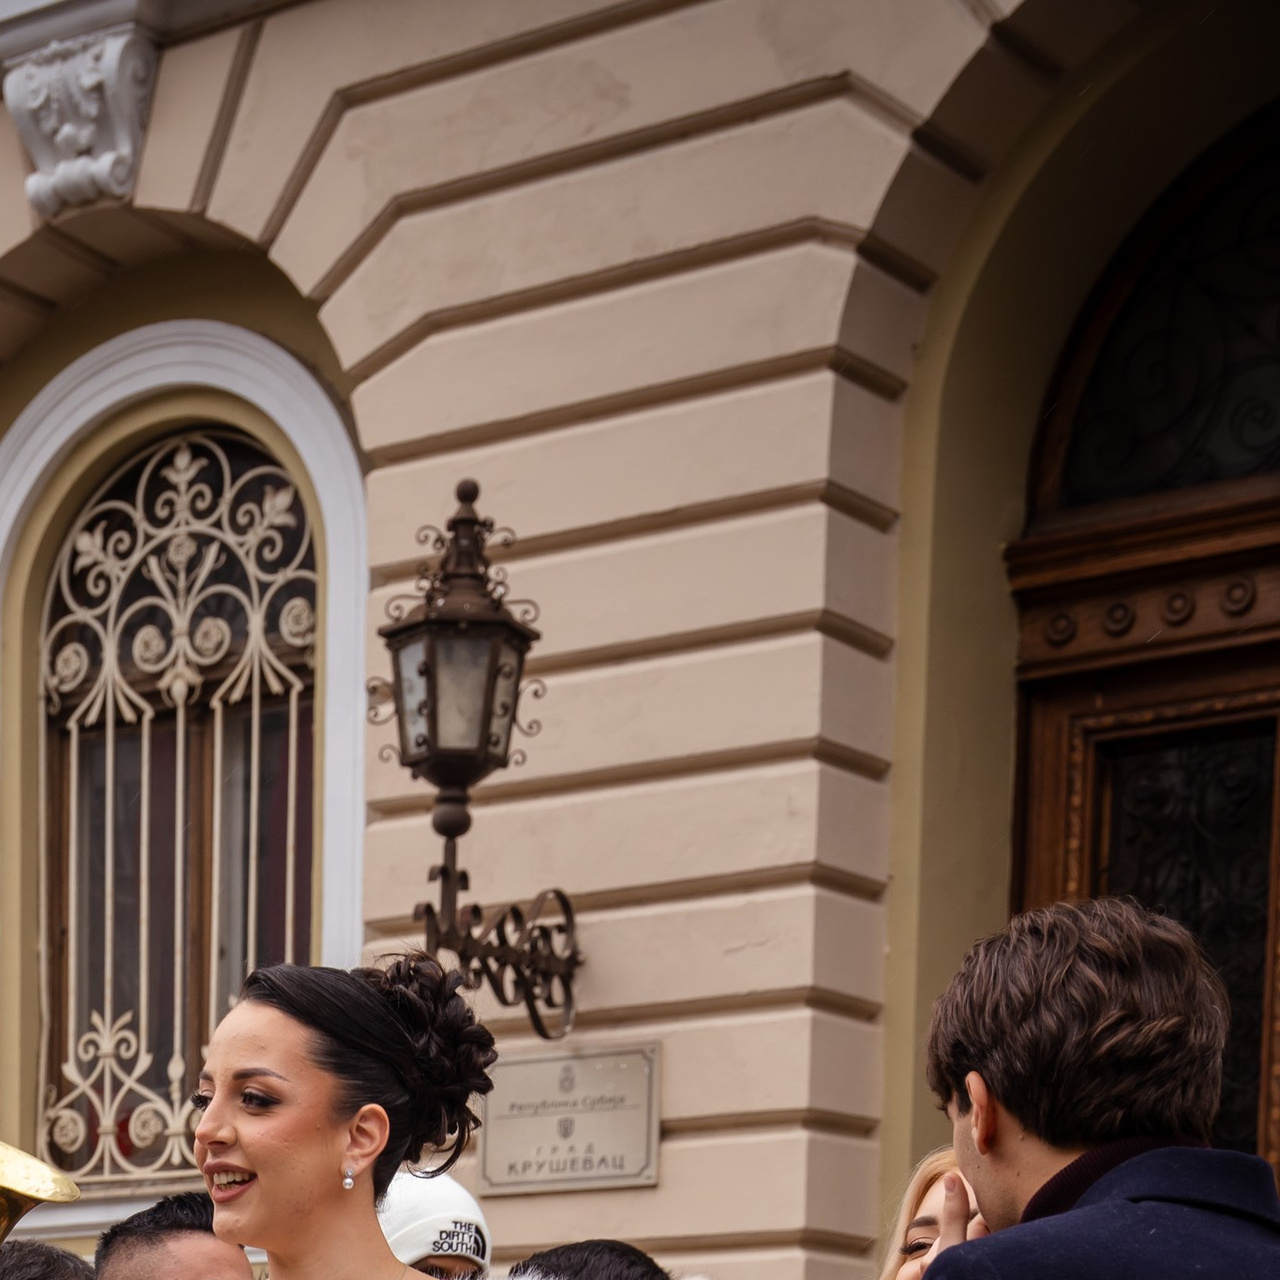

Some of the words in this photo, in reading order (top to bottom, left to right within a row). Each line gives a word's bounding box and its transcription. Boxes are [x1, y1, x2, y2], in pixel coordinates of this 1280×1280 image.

[536, 1142, 594, 1156] ГРАД
[507, 1155, 625, 1176] КРУШЕВАЦ
[452, 1221, 474, 1233] THE
[439, 1230, 474, 1243] DIRTY
[432, 1241, 472, 1255] SOUTH
